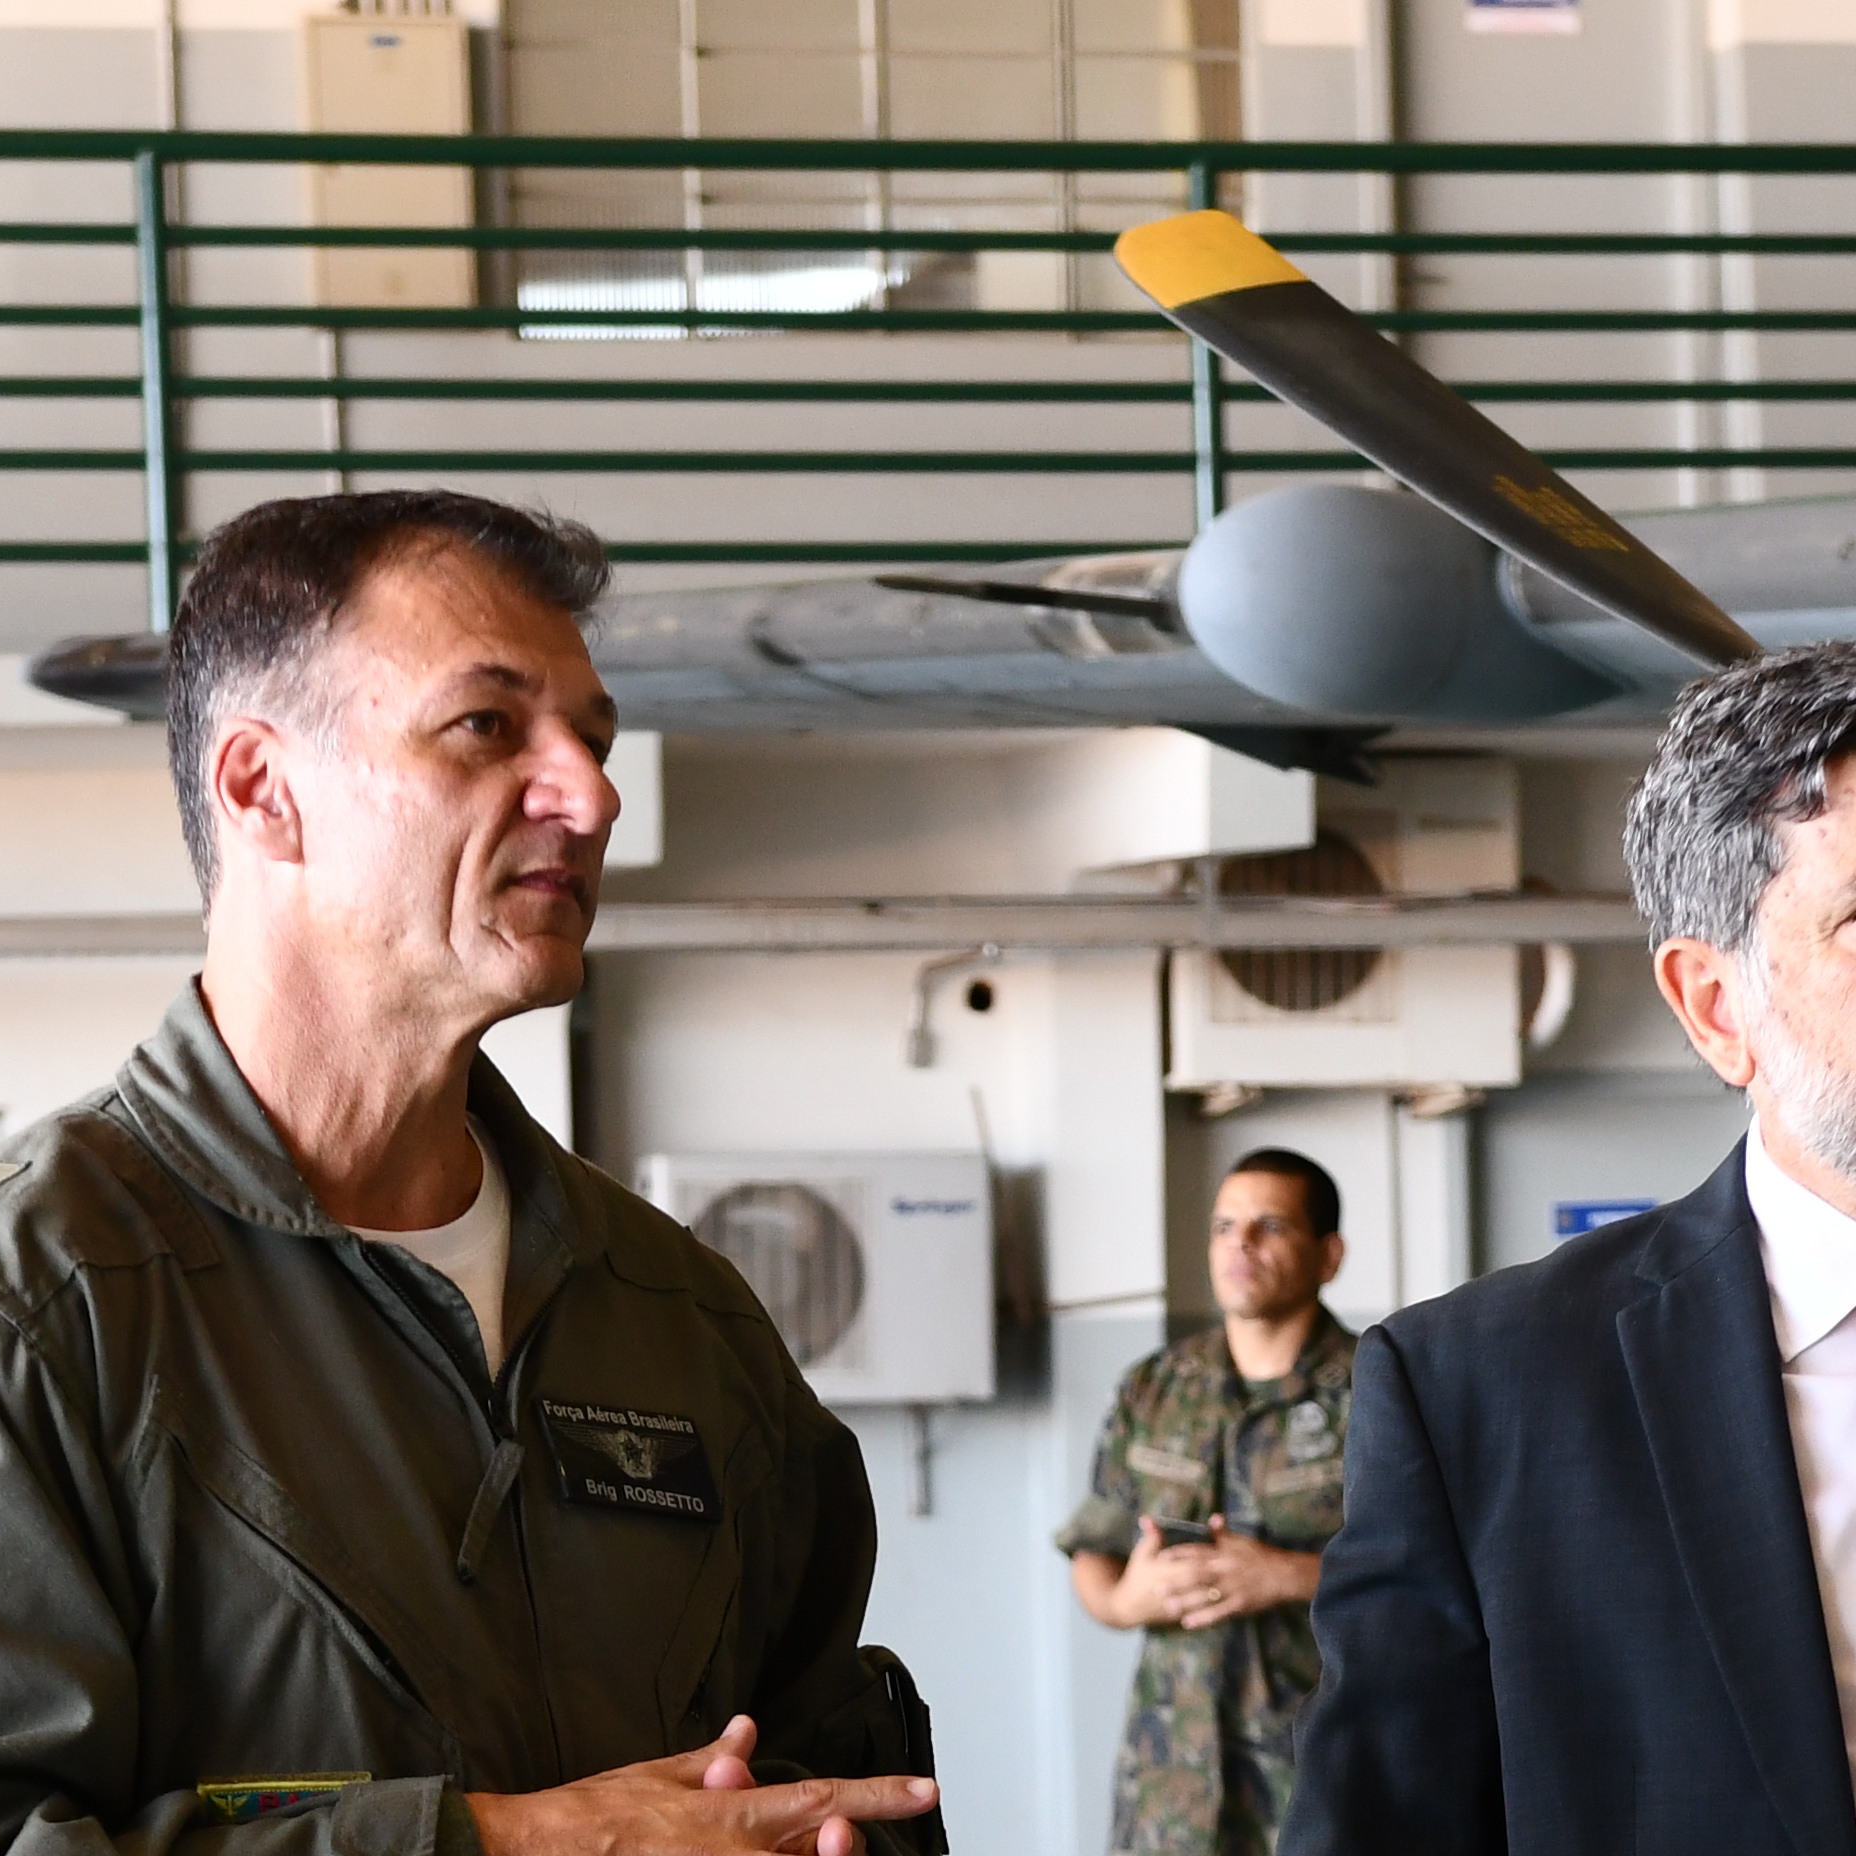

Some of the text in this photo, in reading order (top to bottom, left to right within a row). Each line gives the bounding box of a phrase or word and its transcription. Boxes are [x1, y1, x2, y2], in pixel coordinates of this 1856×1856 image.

[542, 1400, 695, 1434] Força Aérea Brasileira
[585, 1478, 705, 1513] Brig ROSSETTO
